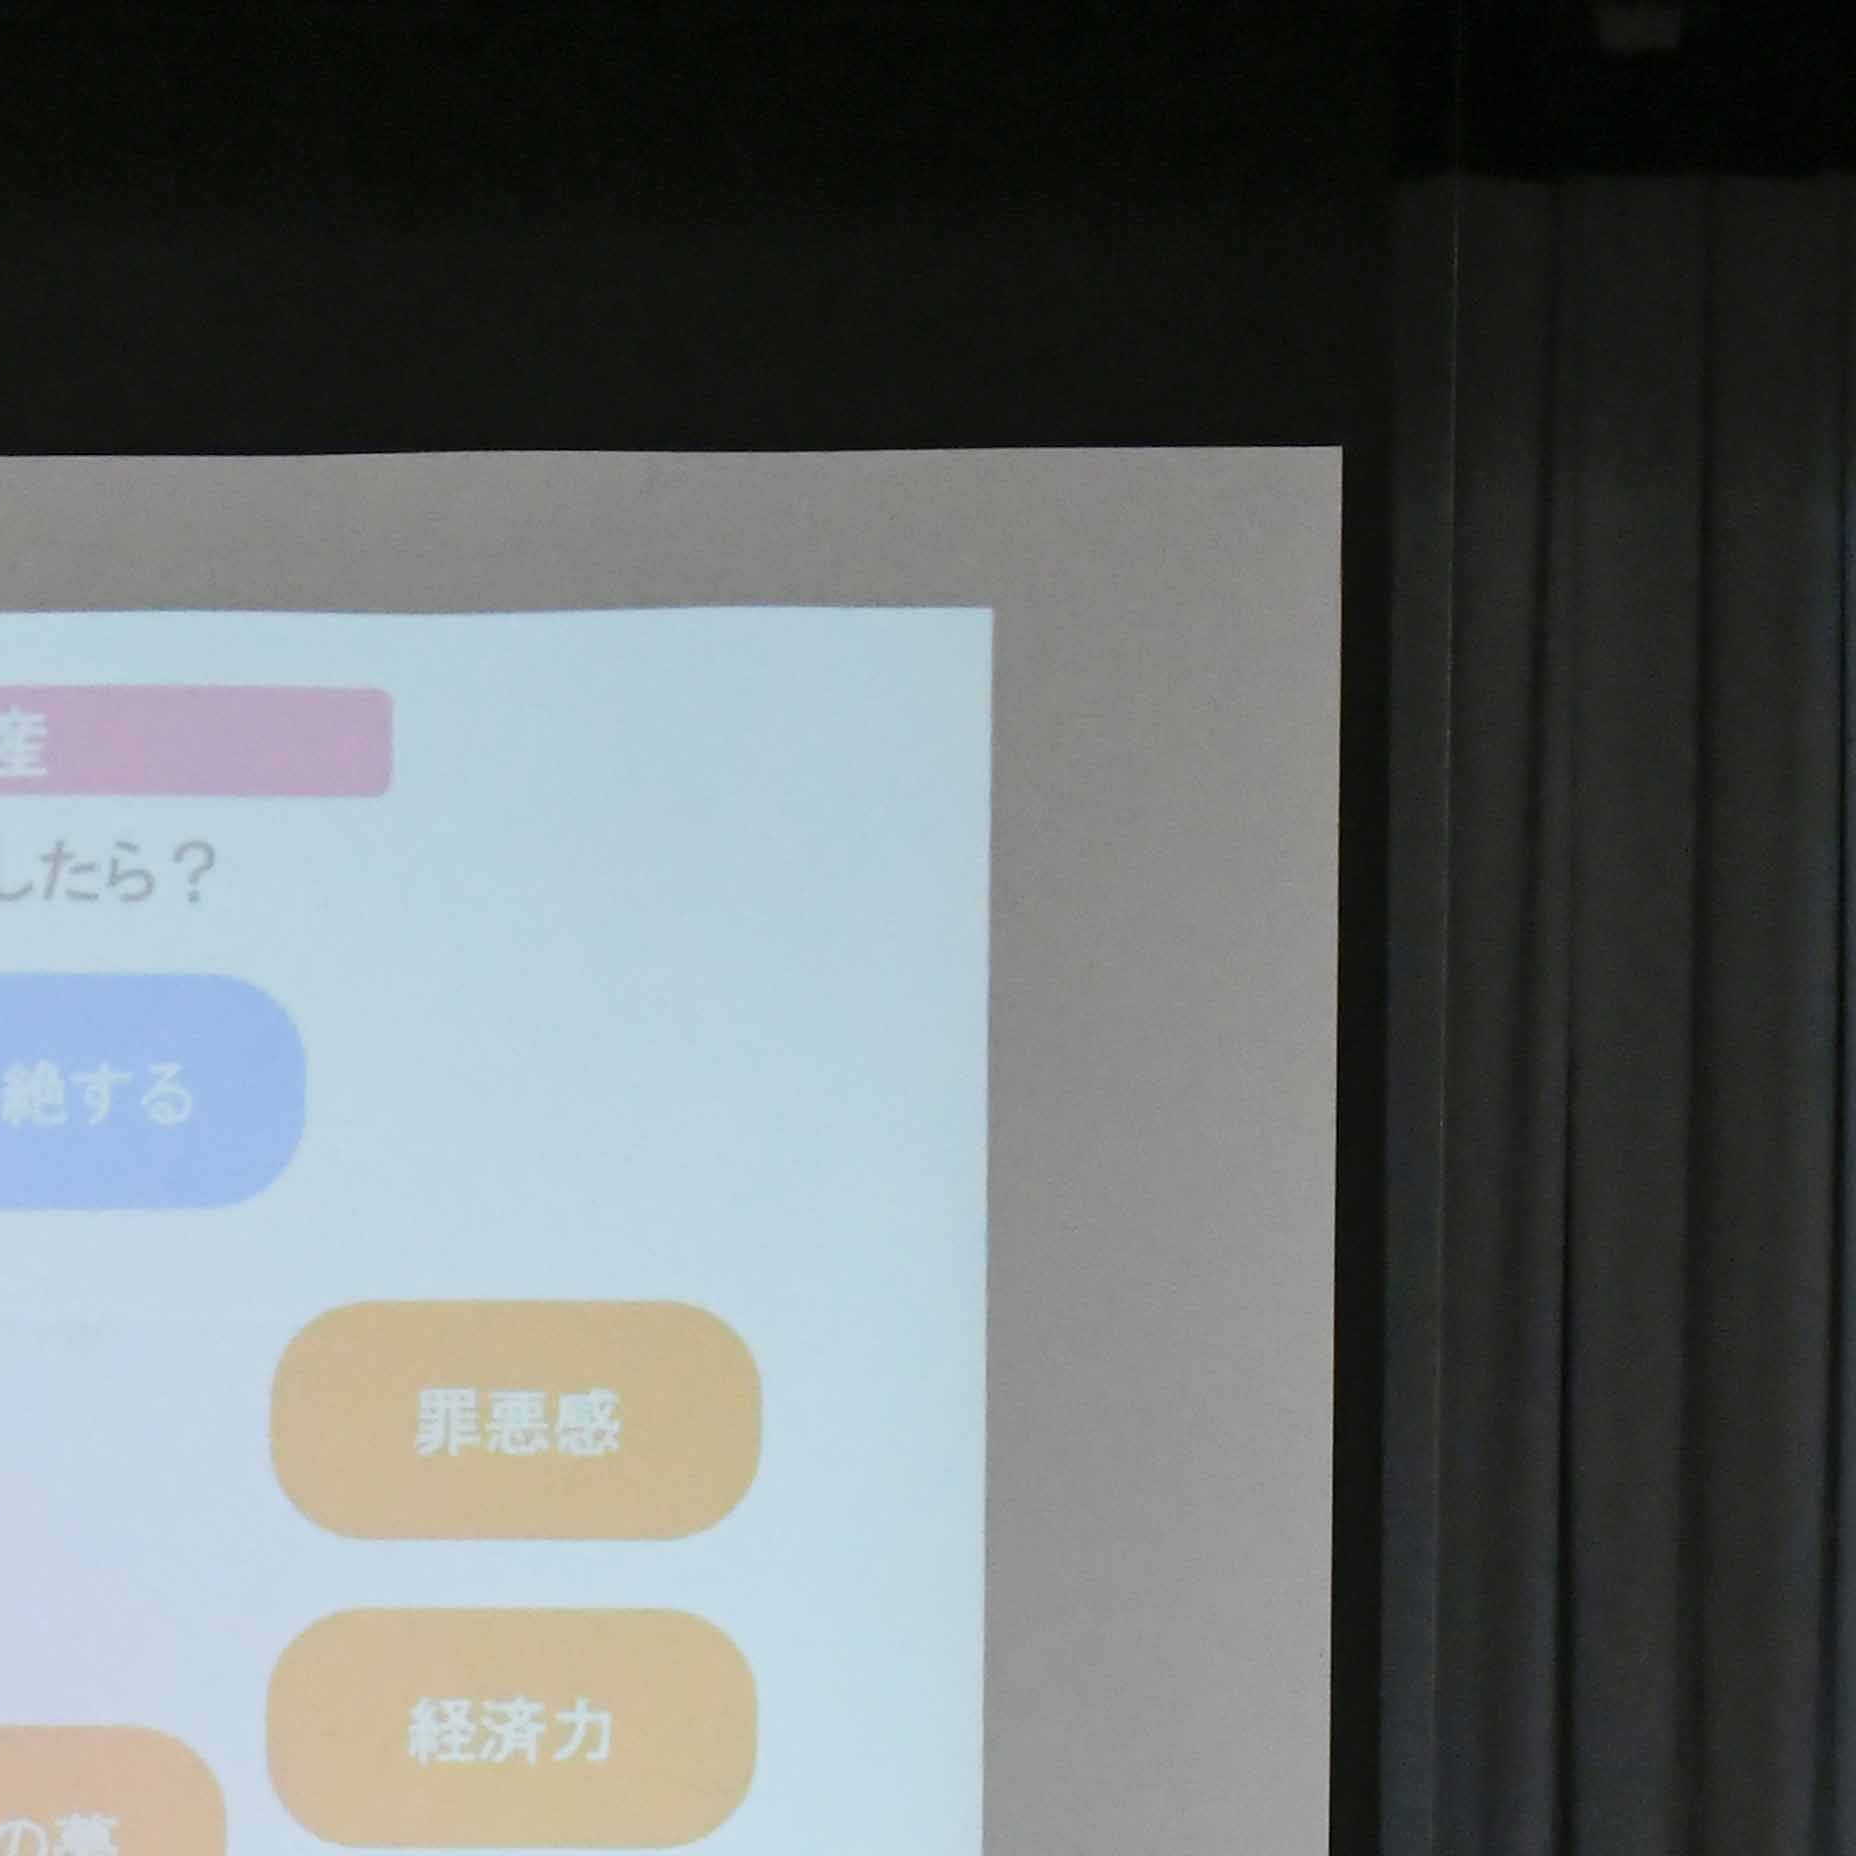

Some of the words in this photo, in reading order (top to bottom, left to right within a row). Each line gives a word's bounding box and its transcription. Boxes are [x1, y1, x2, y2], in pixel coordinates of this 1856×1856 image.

[413, 1386, 623, 1457] 罪悪感
[406, 1696, 615, 1766] 経済力
